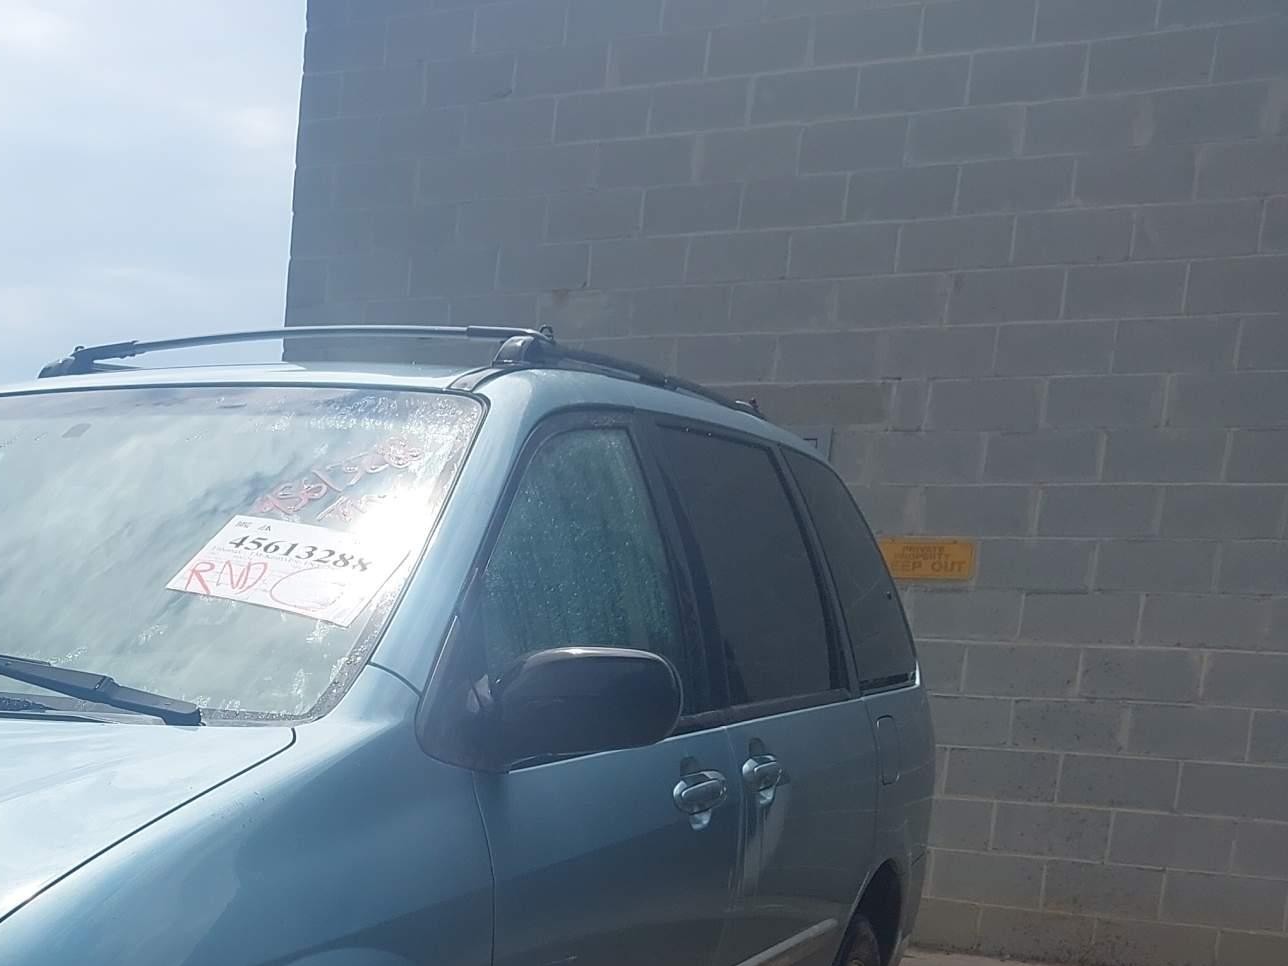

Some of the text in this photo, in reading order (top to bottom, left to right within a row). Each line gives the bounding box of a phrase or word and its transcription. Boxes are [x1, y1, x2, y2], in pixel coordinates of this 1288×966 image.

[229, 534, 372, 573] 45613288
[902, 545, 944, 553] PRIVATE
[894, 552, 952, 561] PROPERTY
[892, 561, 967, 573] EEP OUT
